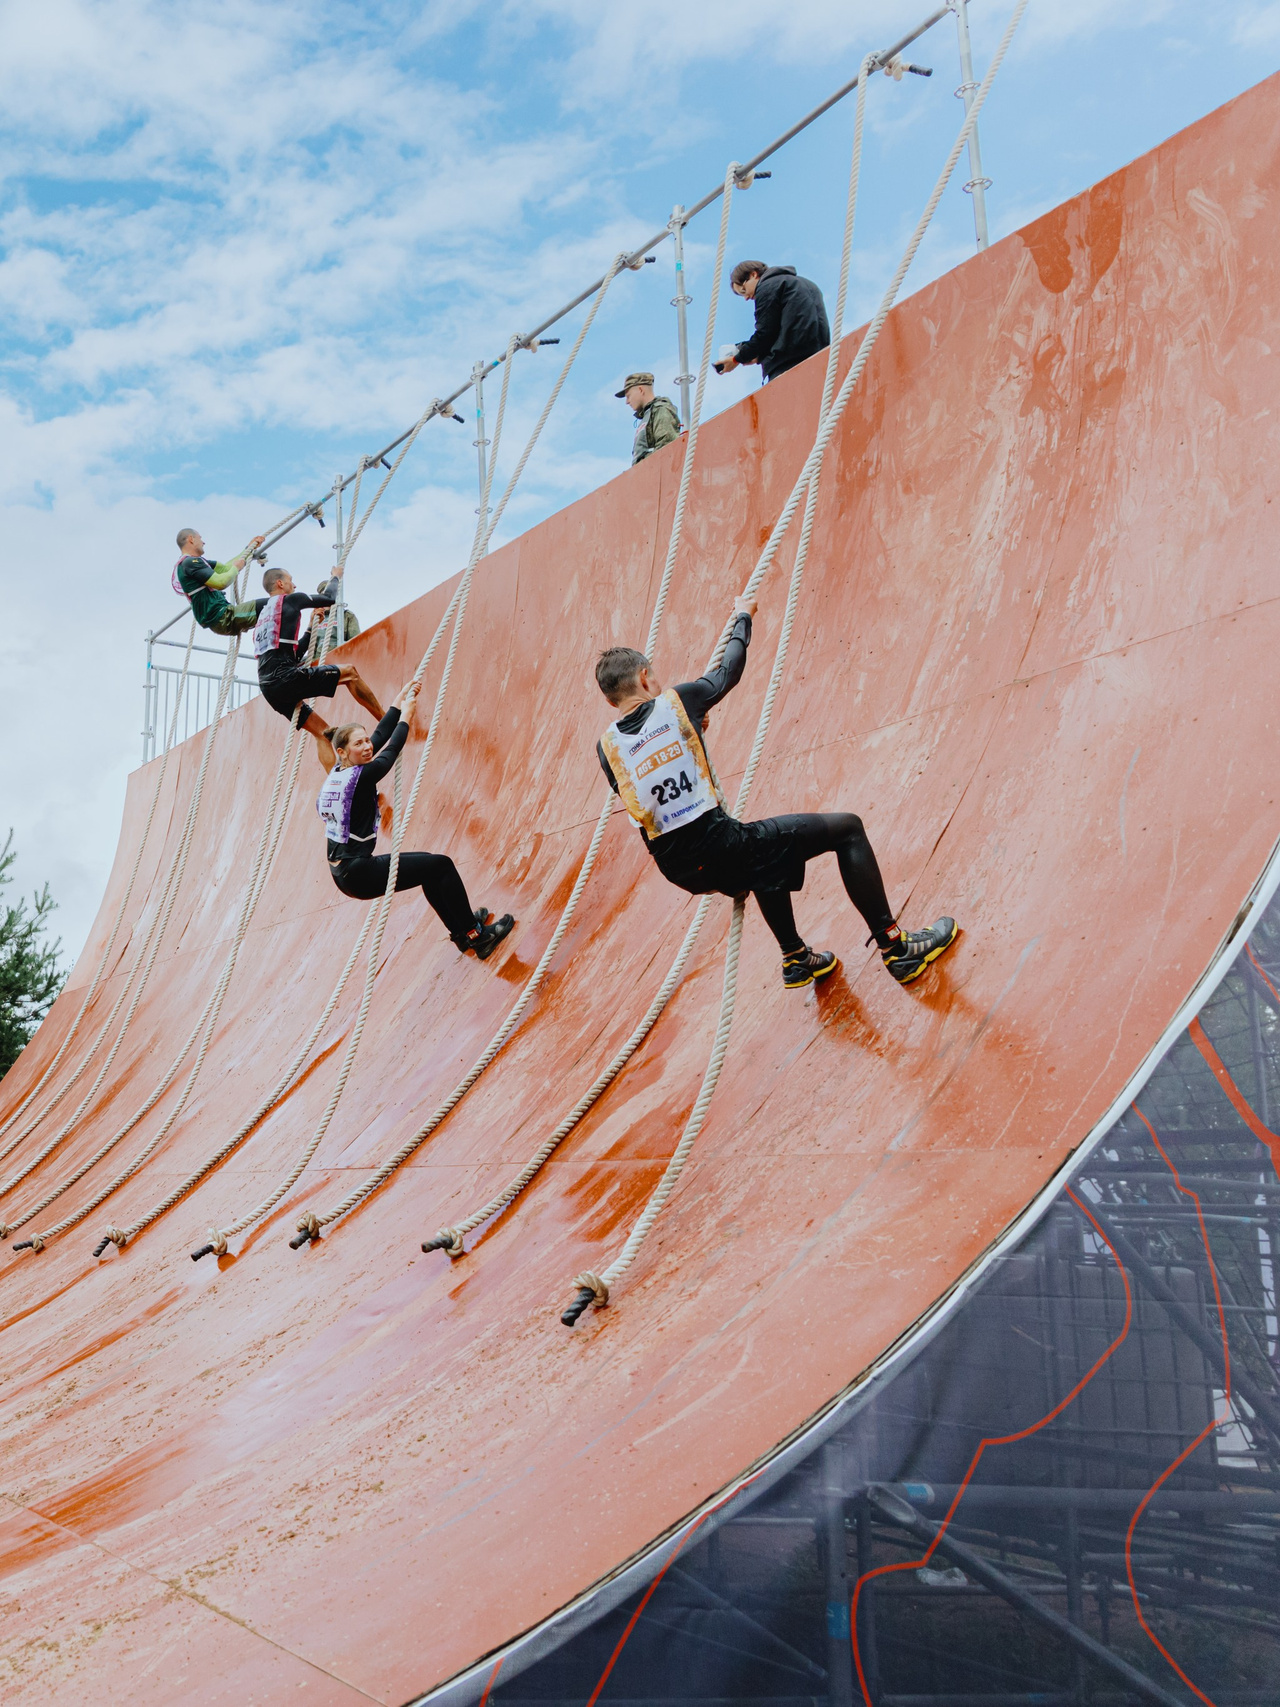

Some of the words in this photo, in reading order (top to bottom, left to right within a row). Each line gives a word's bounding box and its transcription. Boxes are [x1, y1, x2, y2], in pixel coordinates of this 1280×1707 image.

[629, 739, 645, 755] ГОНКА
[645, 723, 670, 740] ГЕРОЕВ
[637, 760, 654, 777] AGE
[654, 744, 681, 765] 18-29
[651, 770, 693, 806] 234
